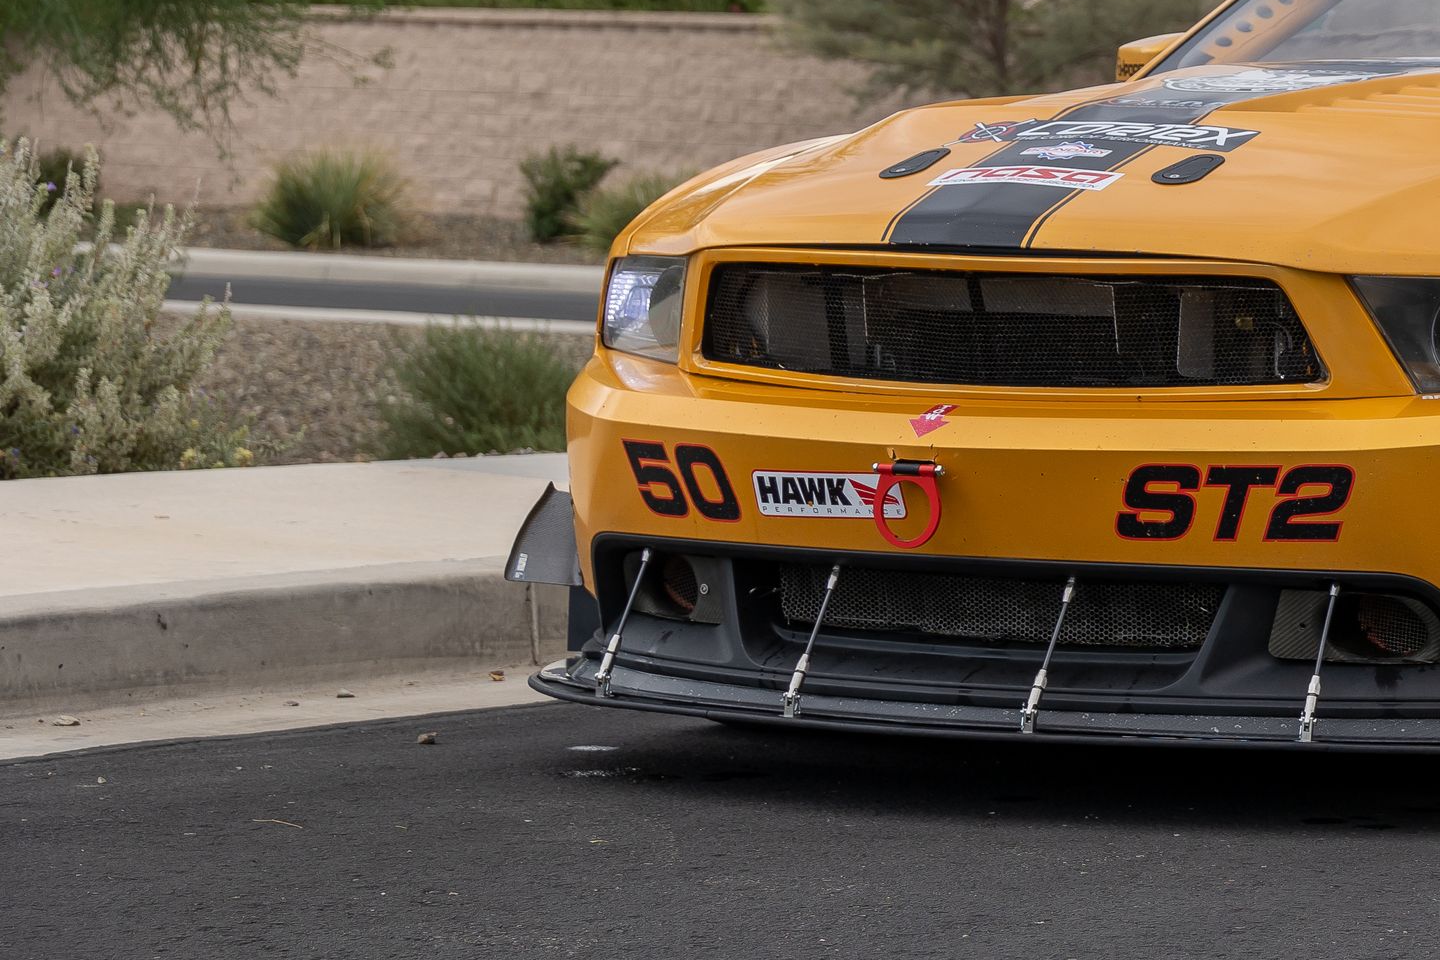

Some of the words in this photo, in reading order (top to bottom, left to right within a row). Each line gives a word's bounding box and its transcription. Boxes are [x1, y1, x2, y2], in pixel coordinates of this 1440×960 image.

[925, 404, 953, 421] TOW
[621, 438, 742, 523] 50
[756, 475, 853, 506] HAWK
[762, 505, 903, 516] PERFORMANCE
[1115, 462, 1357, 543] ST2
